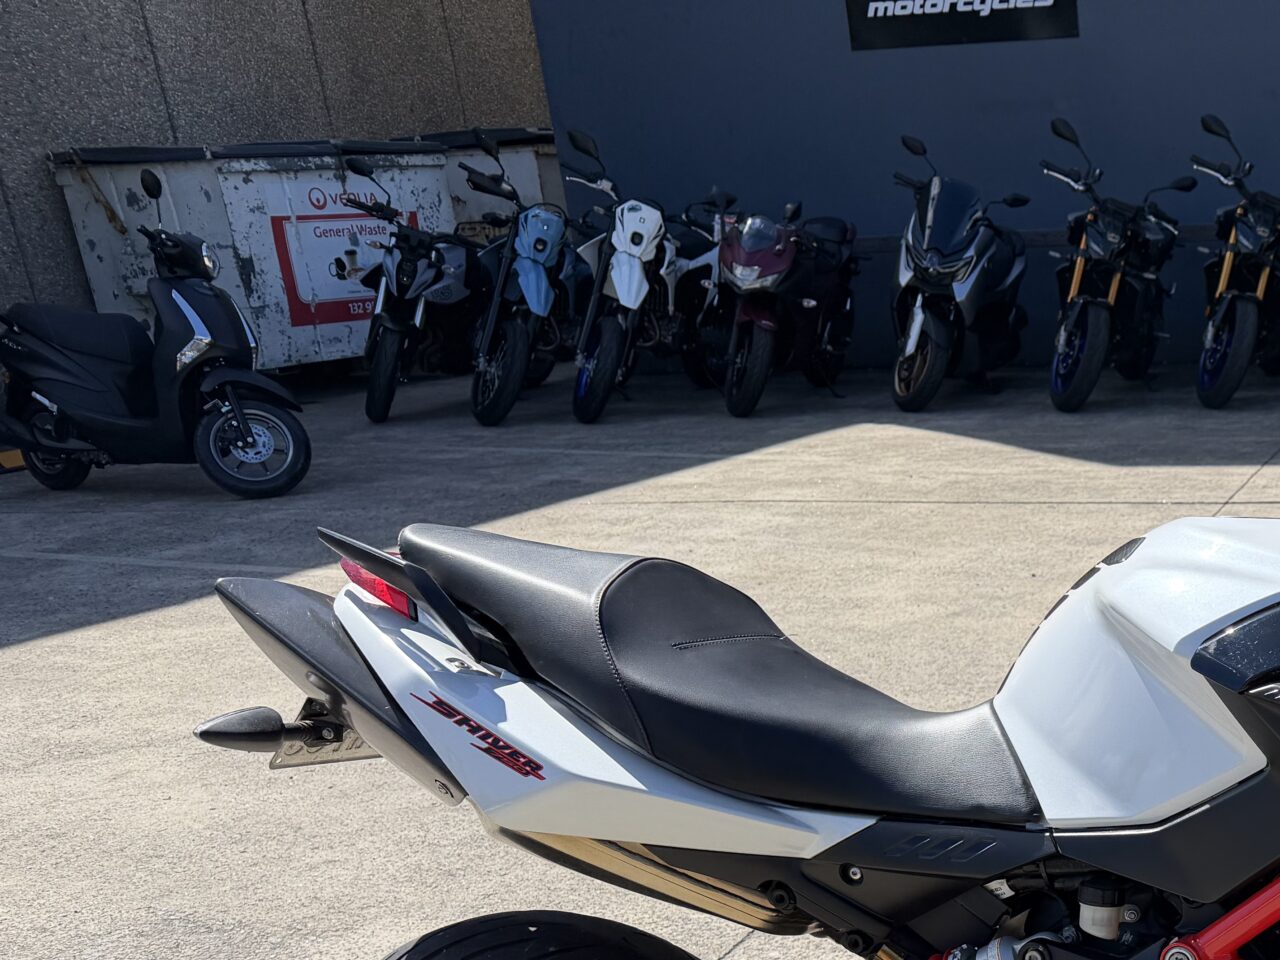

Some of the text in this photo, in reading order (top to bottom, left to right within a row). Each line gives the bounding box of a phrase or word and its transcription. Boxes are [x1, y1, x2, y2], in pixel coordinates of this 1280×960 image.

[313, 224, 387, 238] General Waste
[409, 690, 546, 781] SHIVER
